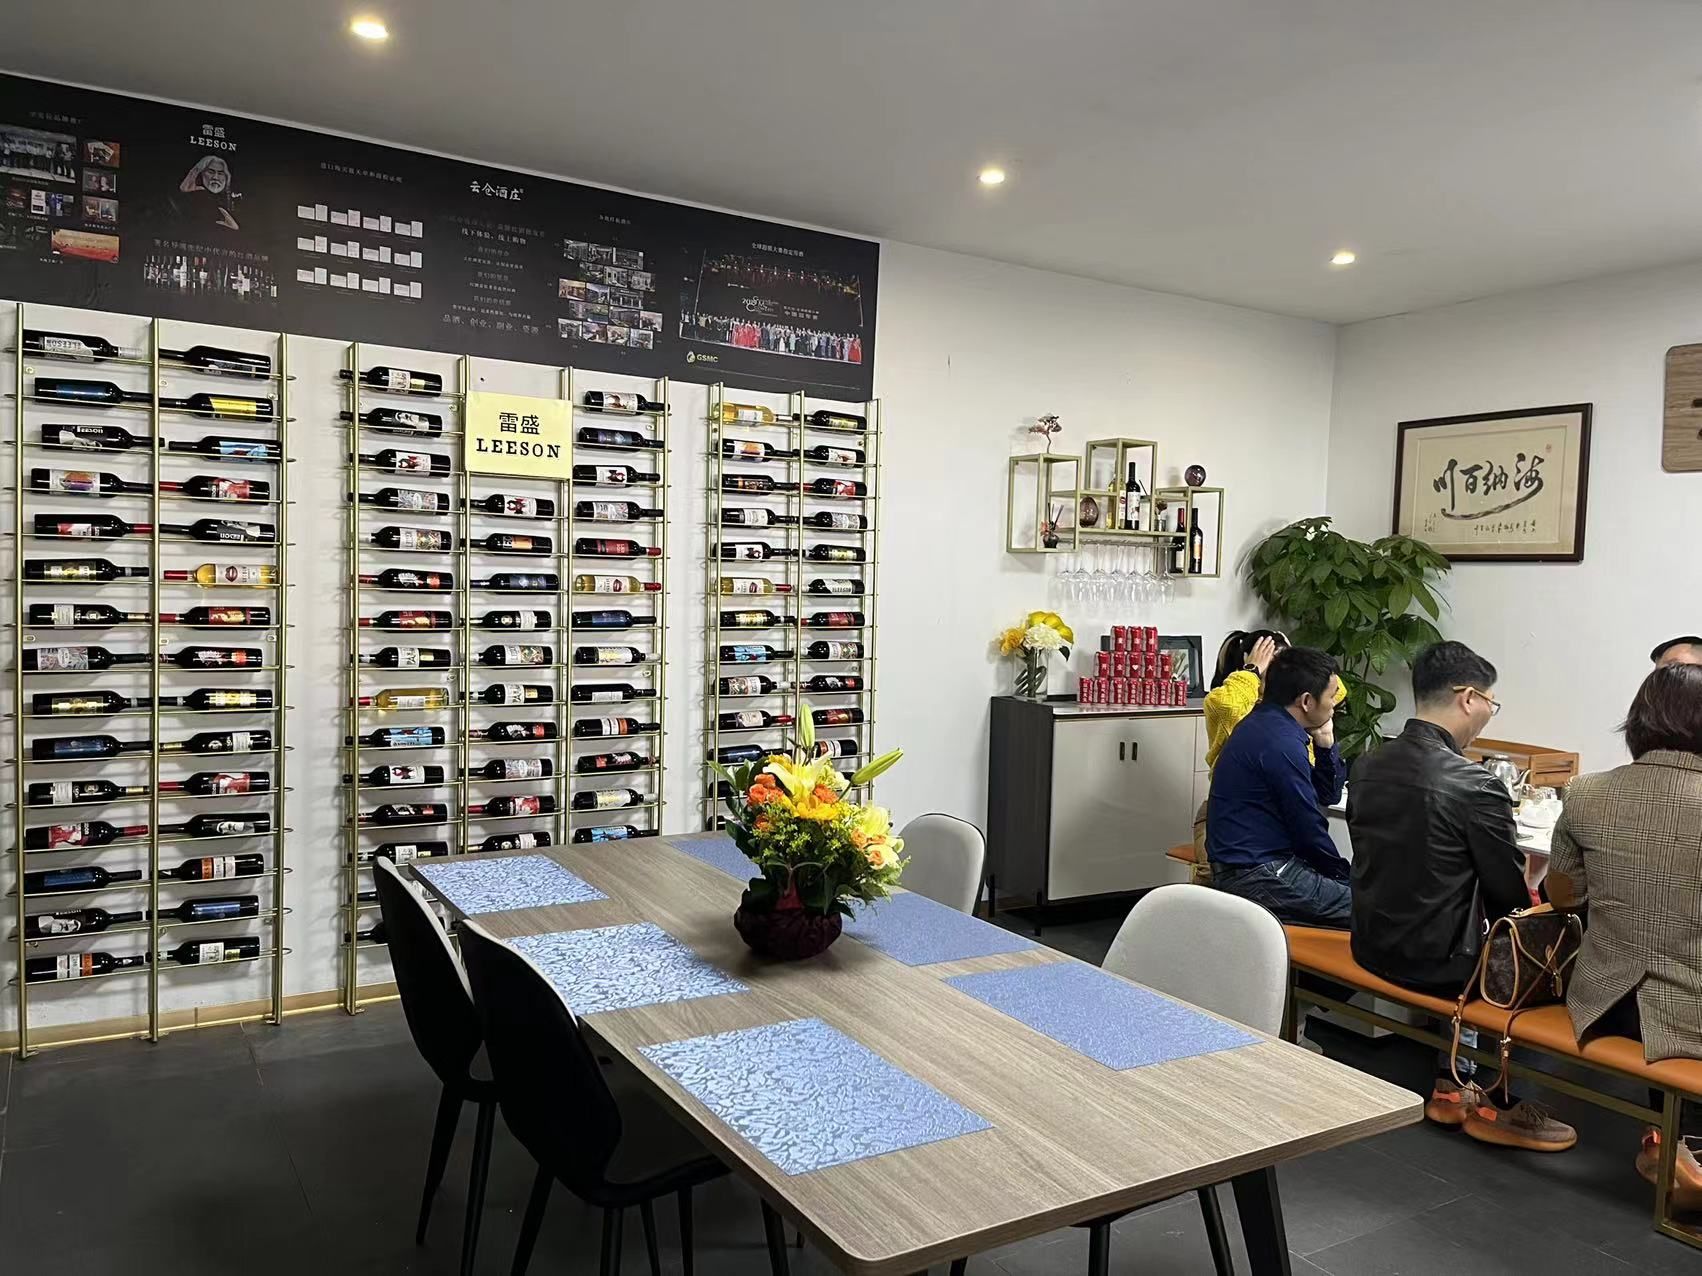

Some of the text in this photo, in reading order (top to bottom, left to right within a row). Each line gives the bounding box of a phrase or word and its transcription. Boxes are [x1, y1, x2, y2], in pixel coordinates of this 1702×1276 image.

[202, 124, 225, 138] 雷盛
[190, 135, 237, 151] LEESON
[470, 180, 521, 201] 云仓酒庄
[696, 353, 719, 363] GSMC
[499, 411, 540, 435] 雷盛
[475, 437, 561, 459] LEESON
[1433, 452, 1546, 515] 海纳百川
